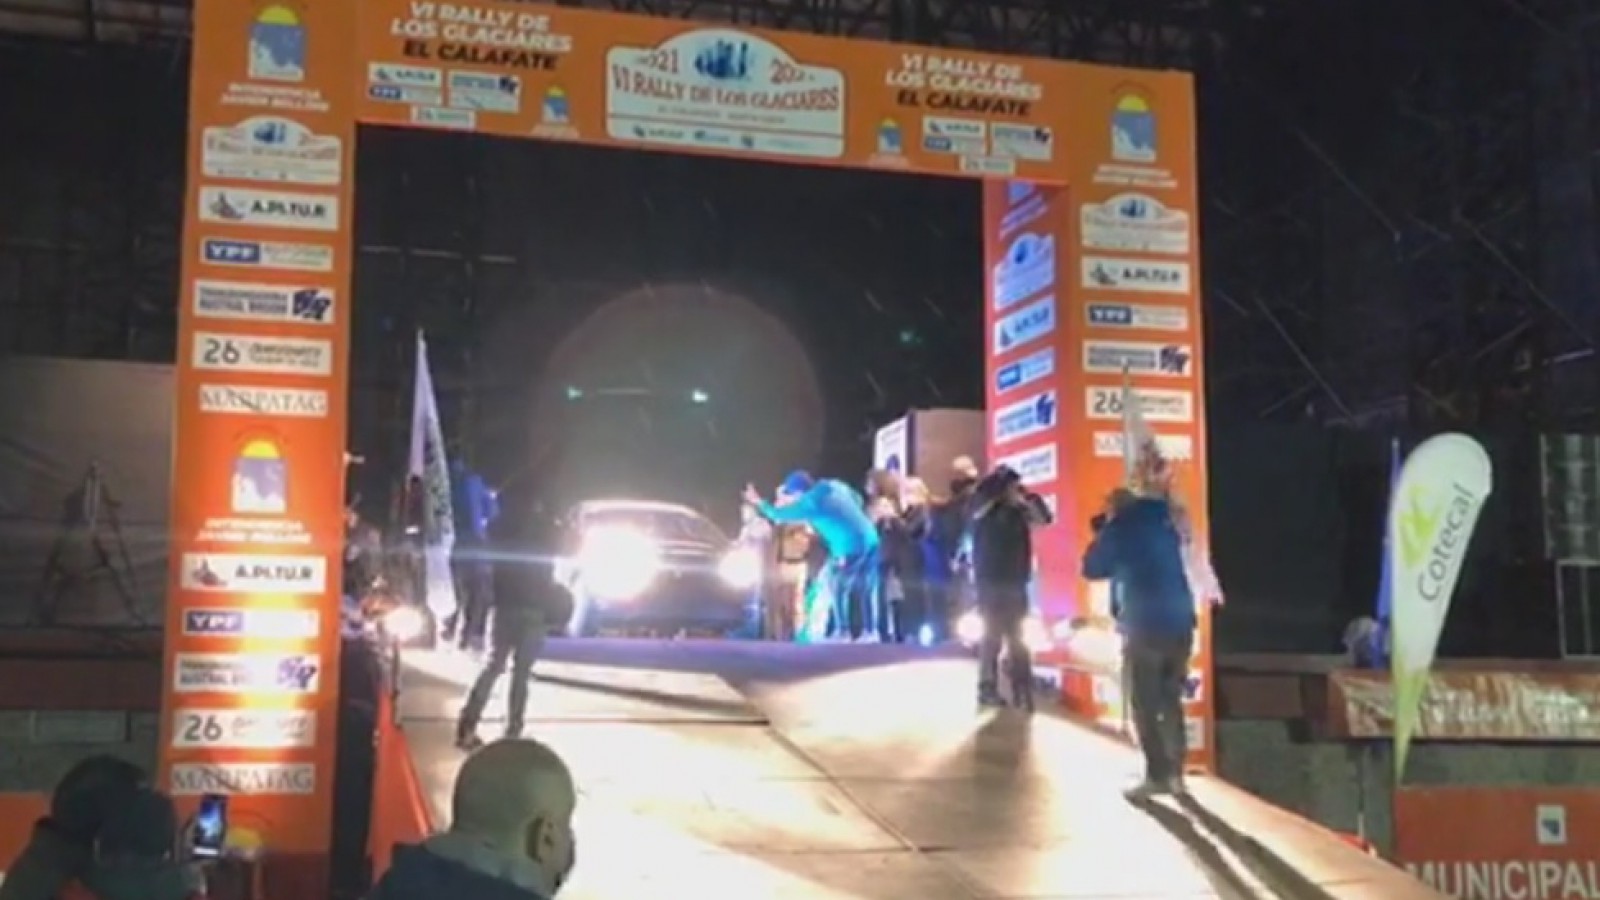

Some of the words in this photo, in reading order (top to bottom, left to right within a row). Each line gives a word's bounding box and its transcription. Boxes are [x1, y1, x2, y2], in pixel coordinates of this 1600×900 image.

[410, 0, 435, 18] VI
[439, 3, 514, 27] RALLY
[517, 12, 550, 32] DE
[389, 17, 437, 38] LOS
[442, 23, 573, 51] GLACIARES
[404, 39, 430, 58] EL
[436, 42, 559, 71] CALAFATE
[927, 56, 992, 76] RALLY
[994, 63, 1023, 80] DE
[633, 72, 685, 100] RALLY
[749, 85, 841, 111] GLACIARES
[885, 69, 924, 87] LOS
[929, 73, 1042, 100] GLACIARES
[897, 88, 919, 106] EL
[925, 91, 1032, 117] CALAFATE
[208, 243, 255, 259] YPF
[203, 337, 241, 365] 26
[1093, 391, 1123, 414] 26
[1417, 482, 1475, 602] Cotecal
[190, 612, 239, 631] YPF
[183, 714, 223, 743] 26
